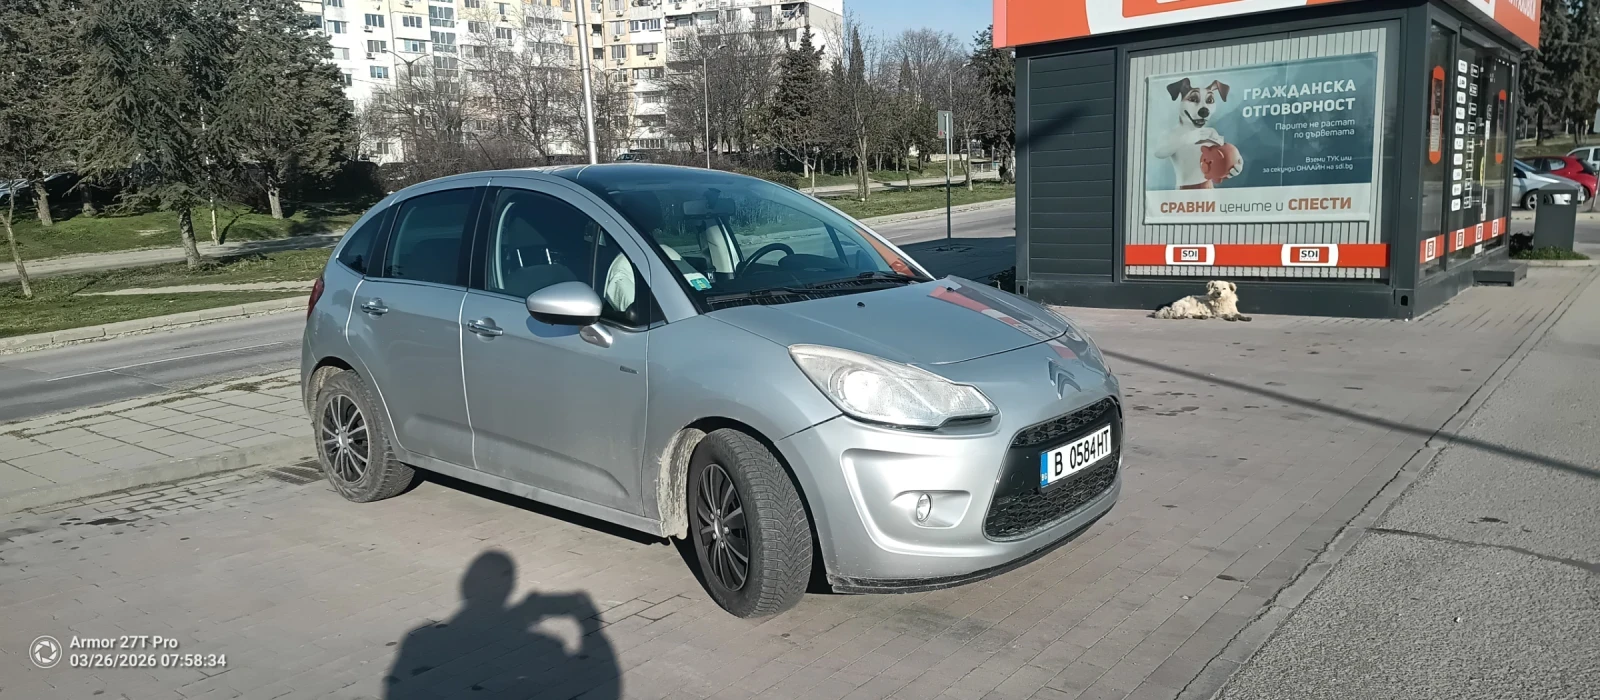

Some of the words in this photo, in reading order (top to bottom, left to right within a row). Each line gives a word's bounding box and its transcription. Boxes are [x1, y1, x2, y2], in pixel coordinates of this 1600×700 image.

[1243, 79, 1356, 100] ГРАЖДАНСКА
[1242, 98, 1356, 118] ОТГОВОРНОСТ
[1275, 122, 1308, 131] Парите
[1320, 119, 1355, 129] растат
[1305, 128, 1355, 140] дърветата
[1296, 163, 1325, 172] ОНЛАЙН
[1335, 163, 1354, 171] sdi.bg
[1160, 201, 1216, 213] СРАВНИ
[1219, 202, 1272, 214] цените
[1275, 202, 1284, 212] и
[1288, 197, 1352, 211] СПЕСТИ
[1182, 250, 1198, 258] SDI
[1300, 250, 1319, 258] SDI
